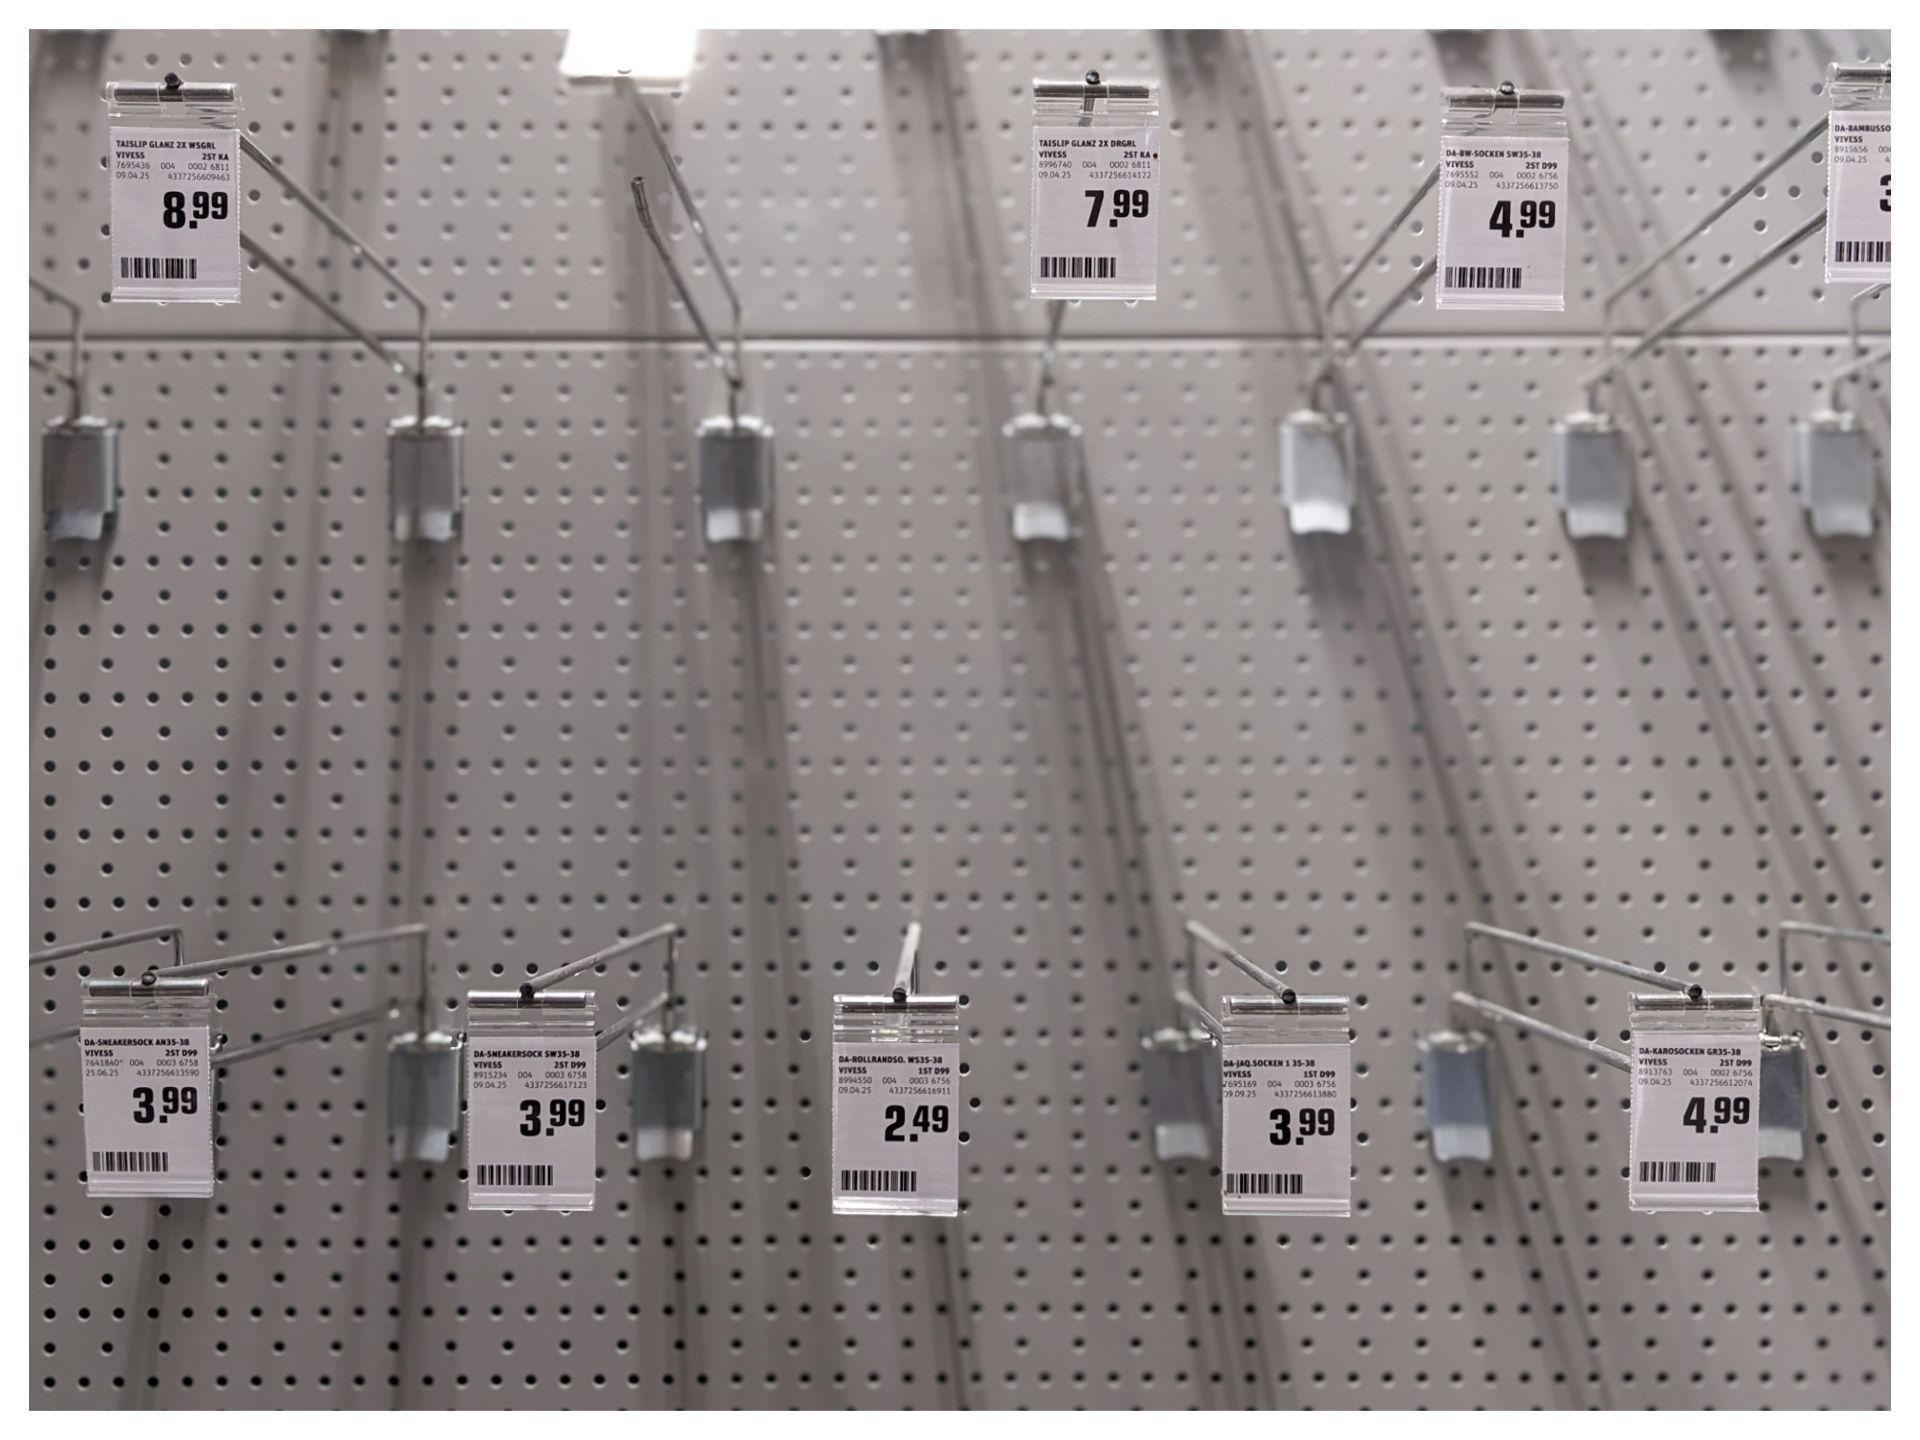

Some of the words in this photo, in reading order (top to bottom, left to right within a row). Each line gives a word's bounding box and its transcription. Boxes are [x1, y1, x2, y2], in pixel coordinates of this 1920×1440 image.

[116, 140, 148, 148] TAISLIP
[149, 141, 175, 149] GLANZ
[176, 141, 187, 149] 2X
[116, 151, 145, 159] VIVESS
[218, 153, 229, 161] KA
[1446, 149, 1504, 158] DA-BW-SOCKEN
[116, 161, 150, 169] 7695436
[160, 162, 176, 170] 004
[188, 163, 208, 171] 0002
[210, 163, 229, 171] 6811
[1109, 161, 1129, 169] 0002
[1131, 161, 1151, 169] 6811
[1542, 162, 1558, 170] D99
[116, 171, 150, 179] 09.04.25
[168, 173, 230, 181] 4337256609463
[1038, 171, 1071, 179] 09.04.25
[1089, 171, 1151, 179] 4337256614122
[1446, 171, 1479, 179] 7695552
[1489, 171, 1504, 179] 004
[1539, 172, 1558, 180] 6756
[1444, 181, 1478, 189] 09.04.25
[1496, 182, 1558, 190] 4337256613750
[163, 191, 228, 229] 8.99
[1084, 189, 1149, 228] 7.99
[1489, 200, 1556, 238] 4.99
[85, 1049, 114, 1057] VIVESS
[165, 1049, 180, 1057] 2ST
[181, 1049, 197, 1057] D99
[474, 1050, 543, 1058] DA-SNEAKERSOCK
[544, 1050, 580, 1058] SW35-38
[1639, 1047, 1705, 1055] DA-KAROSOCKEN
[1706, 1048, 1741, 1056] GR35-38
[839, 1055, 906, 1064] DA-ROLLRANDSO.
[907, 1056, 943, 1064] WS35-38
[1720, 1059, 1734, 1067] 2ST
[1736, 1059, 1752, 1067] D99
[474, 1061, 502, 1069] VIVESS
[554, 1061, 569, 1069] 2ST
[570, 1061, 586, 1069] D99
[86, 1069, 119, 1077] 25.06.25
[137, 1069, 199, 1077] 4337256613590
[474, 1071, 508, 1079] 8915234
[517, 1071, 532, 1079] 004
[545, 1071, 565, 1079] 0003
[567, 1071, 587, 1079] 6758
[839, 1066, 867, 1074] VIVESS
[918, 1067, 932, 1075] 1ST
[934, 1067, 950, 1075] D99
[1223, 1070, 1252, 1078] VIVESS
[1303, 1070, 1318, 1078] 1ST
[1319, 1070, 1336, 1078] D99
[1639, 1068, 1673, 1076] 8913763
[1682, 1068, 1698, 1076] 004
[1710, 1069, 1730, 1077] 0002
[1733, 1069, 1753, 1077] 6756
[473, 1081, 507, 1089] 09.04.25
[525, 1081, 587, 1089] 4337256617123
[838, 1076, 872, 1084] 8994550
[882, 1076, 897, 1084] 004
[931, 1077, 951, 1085] 6756
[1267, 1080, 1282, 1088] 004
[1294, 1080, 1314, 1088] 0003
[1317, 1080, 1336, 1088] 6756
[1638, 1078, 1672, 1086] 09.04.25
[1689, 1079, 1753, 1087] 4337256612074
[838, 1086, 872, 1094] 09.04.25
[889, 1087, 951, 1095] 4337256616911
[1274, 1090, 1337, 1098] 4337256613880
[132, 1086, 198, 1124] 3.99
[519, 1098, 585, 1137] 3.99
[1682, 1096, 1750, 1134] 4.99
[884, 1104, 949, 1142] 2.49
[1269, 1108, 1335, 1146] 3.99
